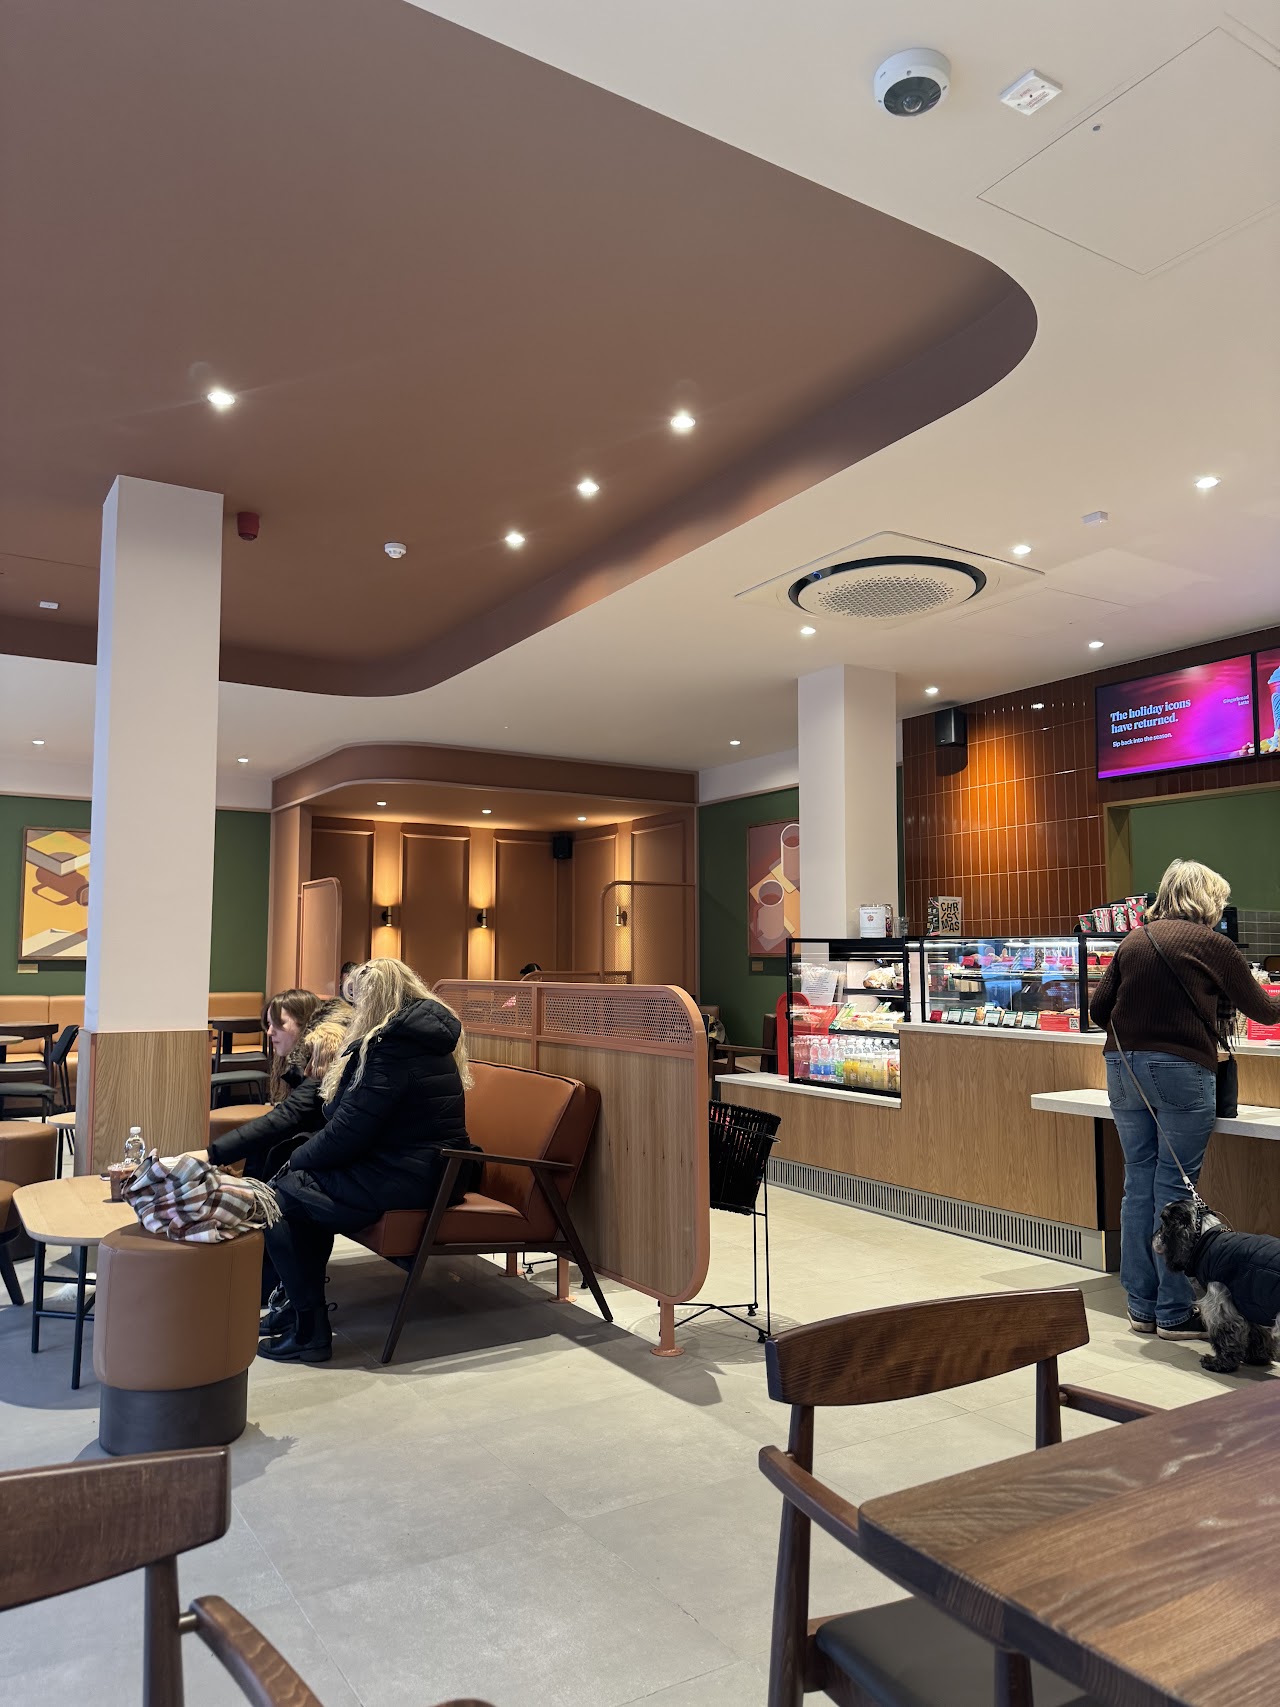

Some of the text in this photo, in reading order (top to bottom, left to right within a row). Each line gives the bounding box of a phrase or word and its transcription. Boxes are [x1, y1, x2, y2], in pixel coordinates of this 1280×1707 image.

[1110, 699, 1191, 722] The holiday icons
[1111, 712, 1179, 734] have returned.
